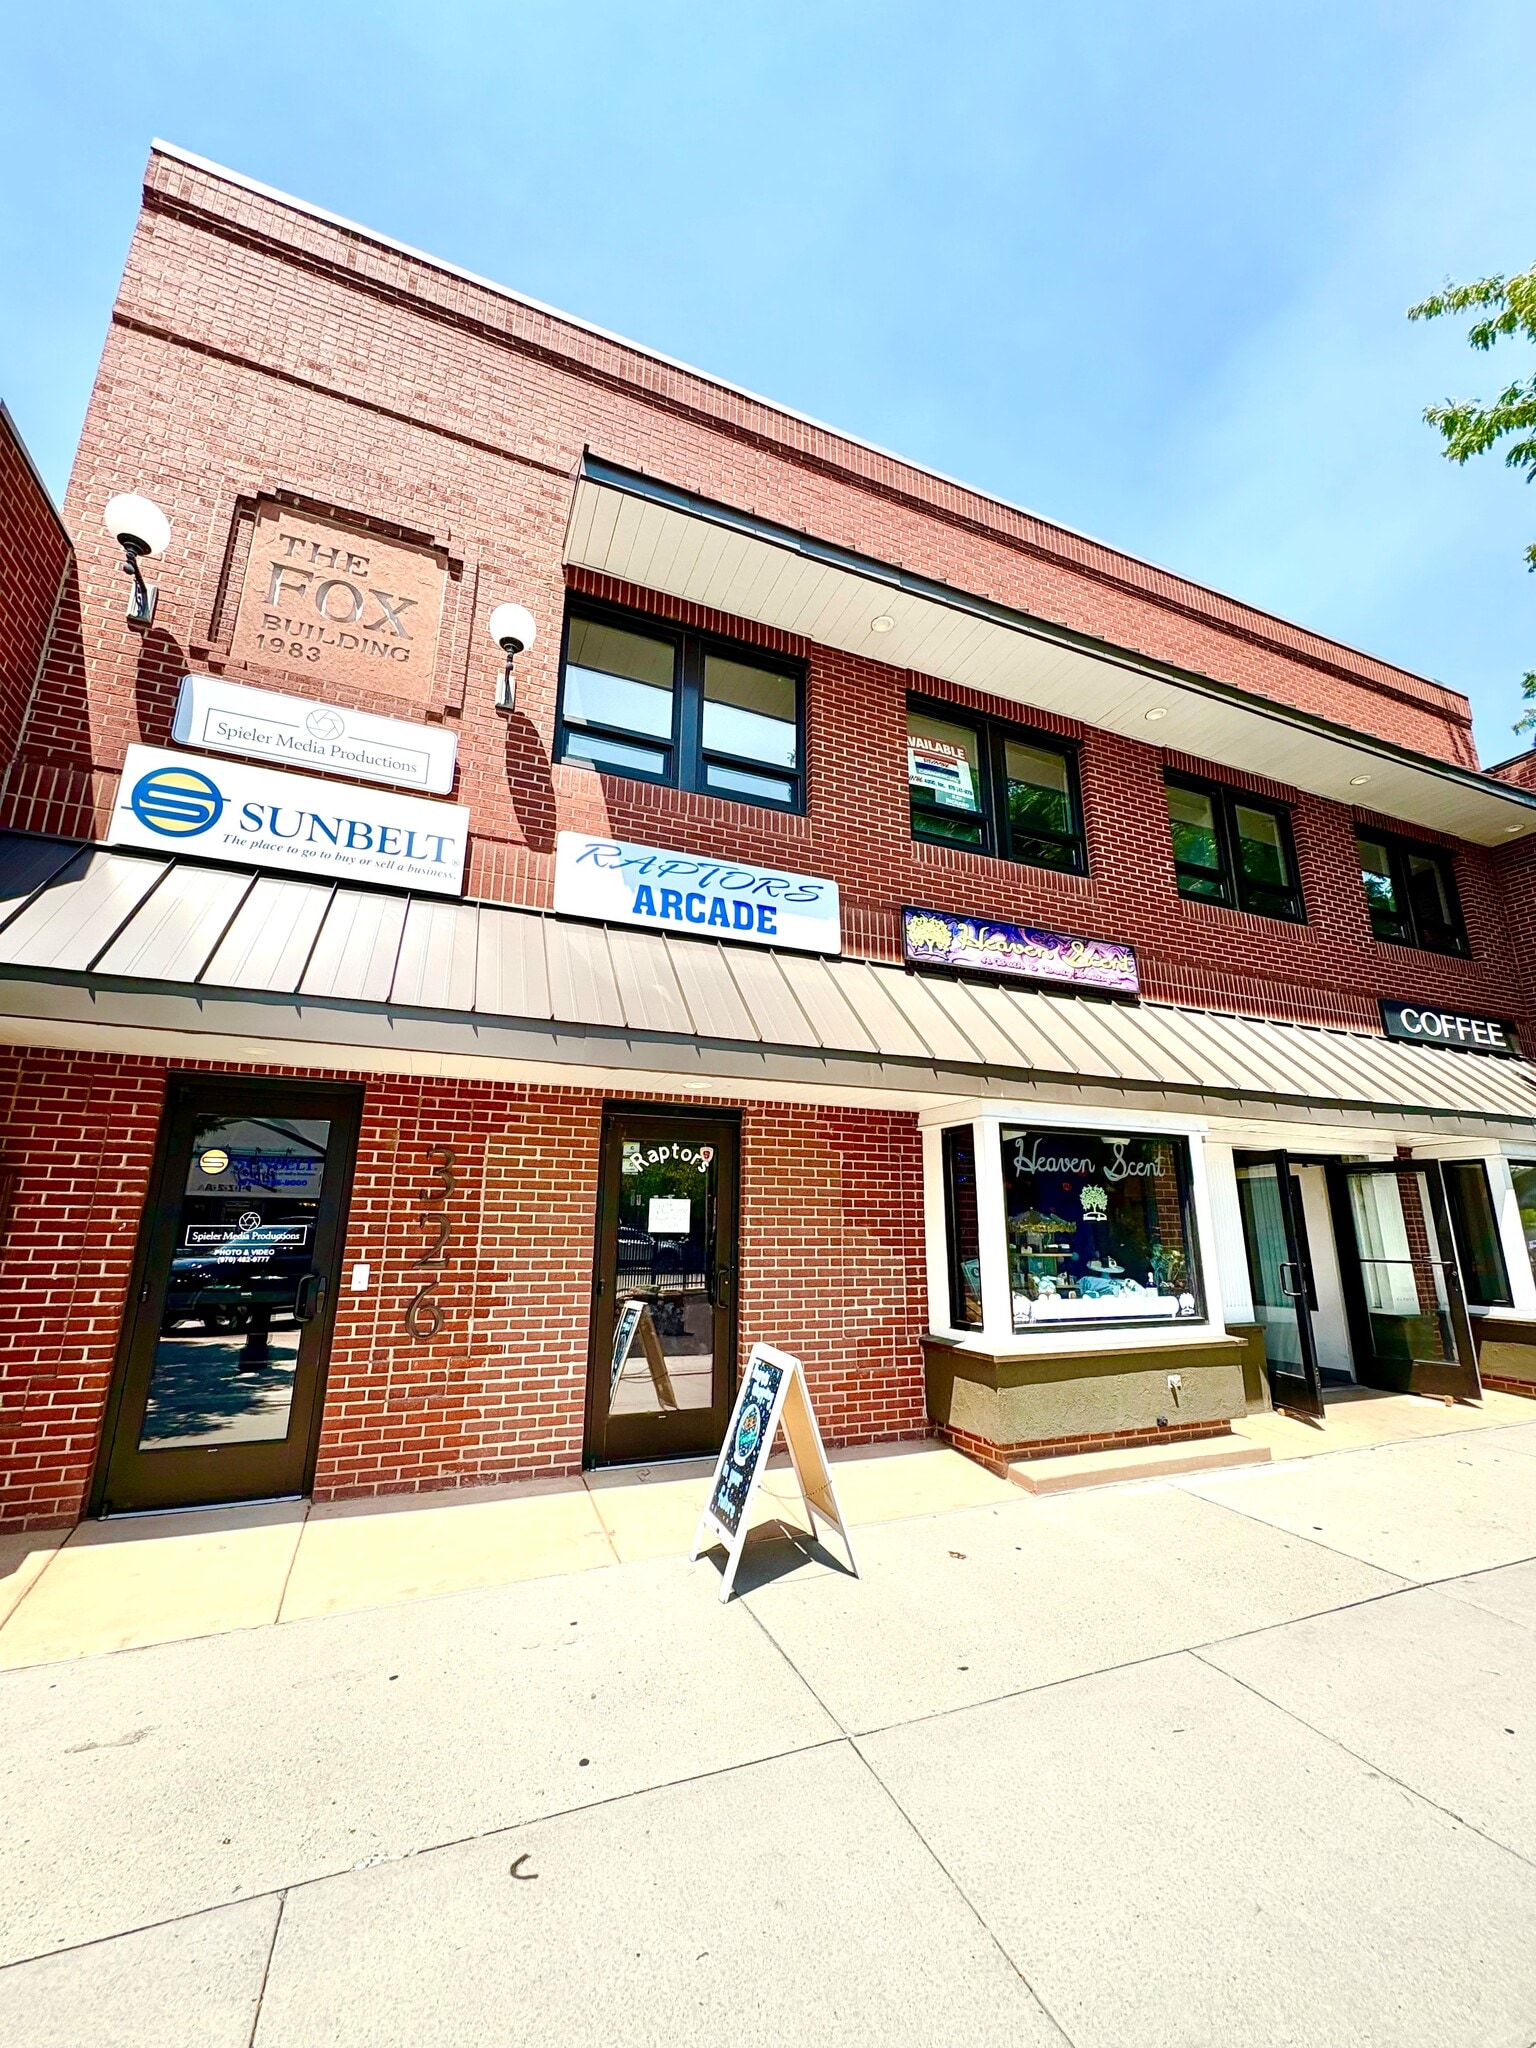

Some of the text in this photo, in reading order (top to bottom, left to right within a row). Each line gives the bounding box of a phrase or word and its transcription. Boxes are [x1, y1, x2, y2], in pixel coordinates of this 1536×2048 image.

[279, 534, 370, 577] THE
[261, 561, 418, 640] FOX
[256, 634, 321, 662] 1983
[262, 613, 411, 662] BUILDING
[217, 722, 417, 773] Spieler Media Productions
[223, 833, 247, 846] The
[250, 840, 283, 853] place
[287, 845, 298, 854] to
[302, 849, 317, 858] go
[320, 850, 332, 860] to
[335, 852, 356, 865] buy
[359, 858, 372, 866] or
[375, 859, 395, 870] sell
[240, 803, 455, 863] SUNBELT
[576, 843, 824, 902] RAPTORS
[632, 884, 777, 935] ARCADE
[957, 923, 1134, 973] Heaven Scent
[1400, 1008, 1506, 1047] COFFEE
[630, 1143, 709, 1173] Raptors
[1014, 1138, 1165, 1181] Heaven Scent
[193, 1231, 300, 1242] Spieler Media Productions
